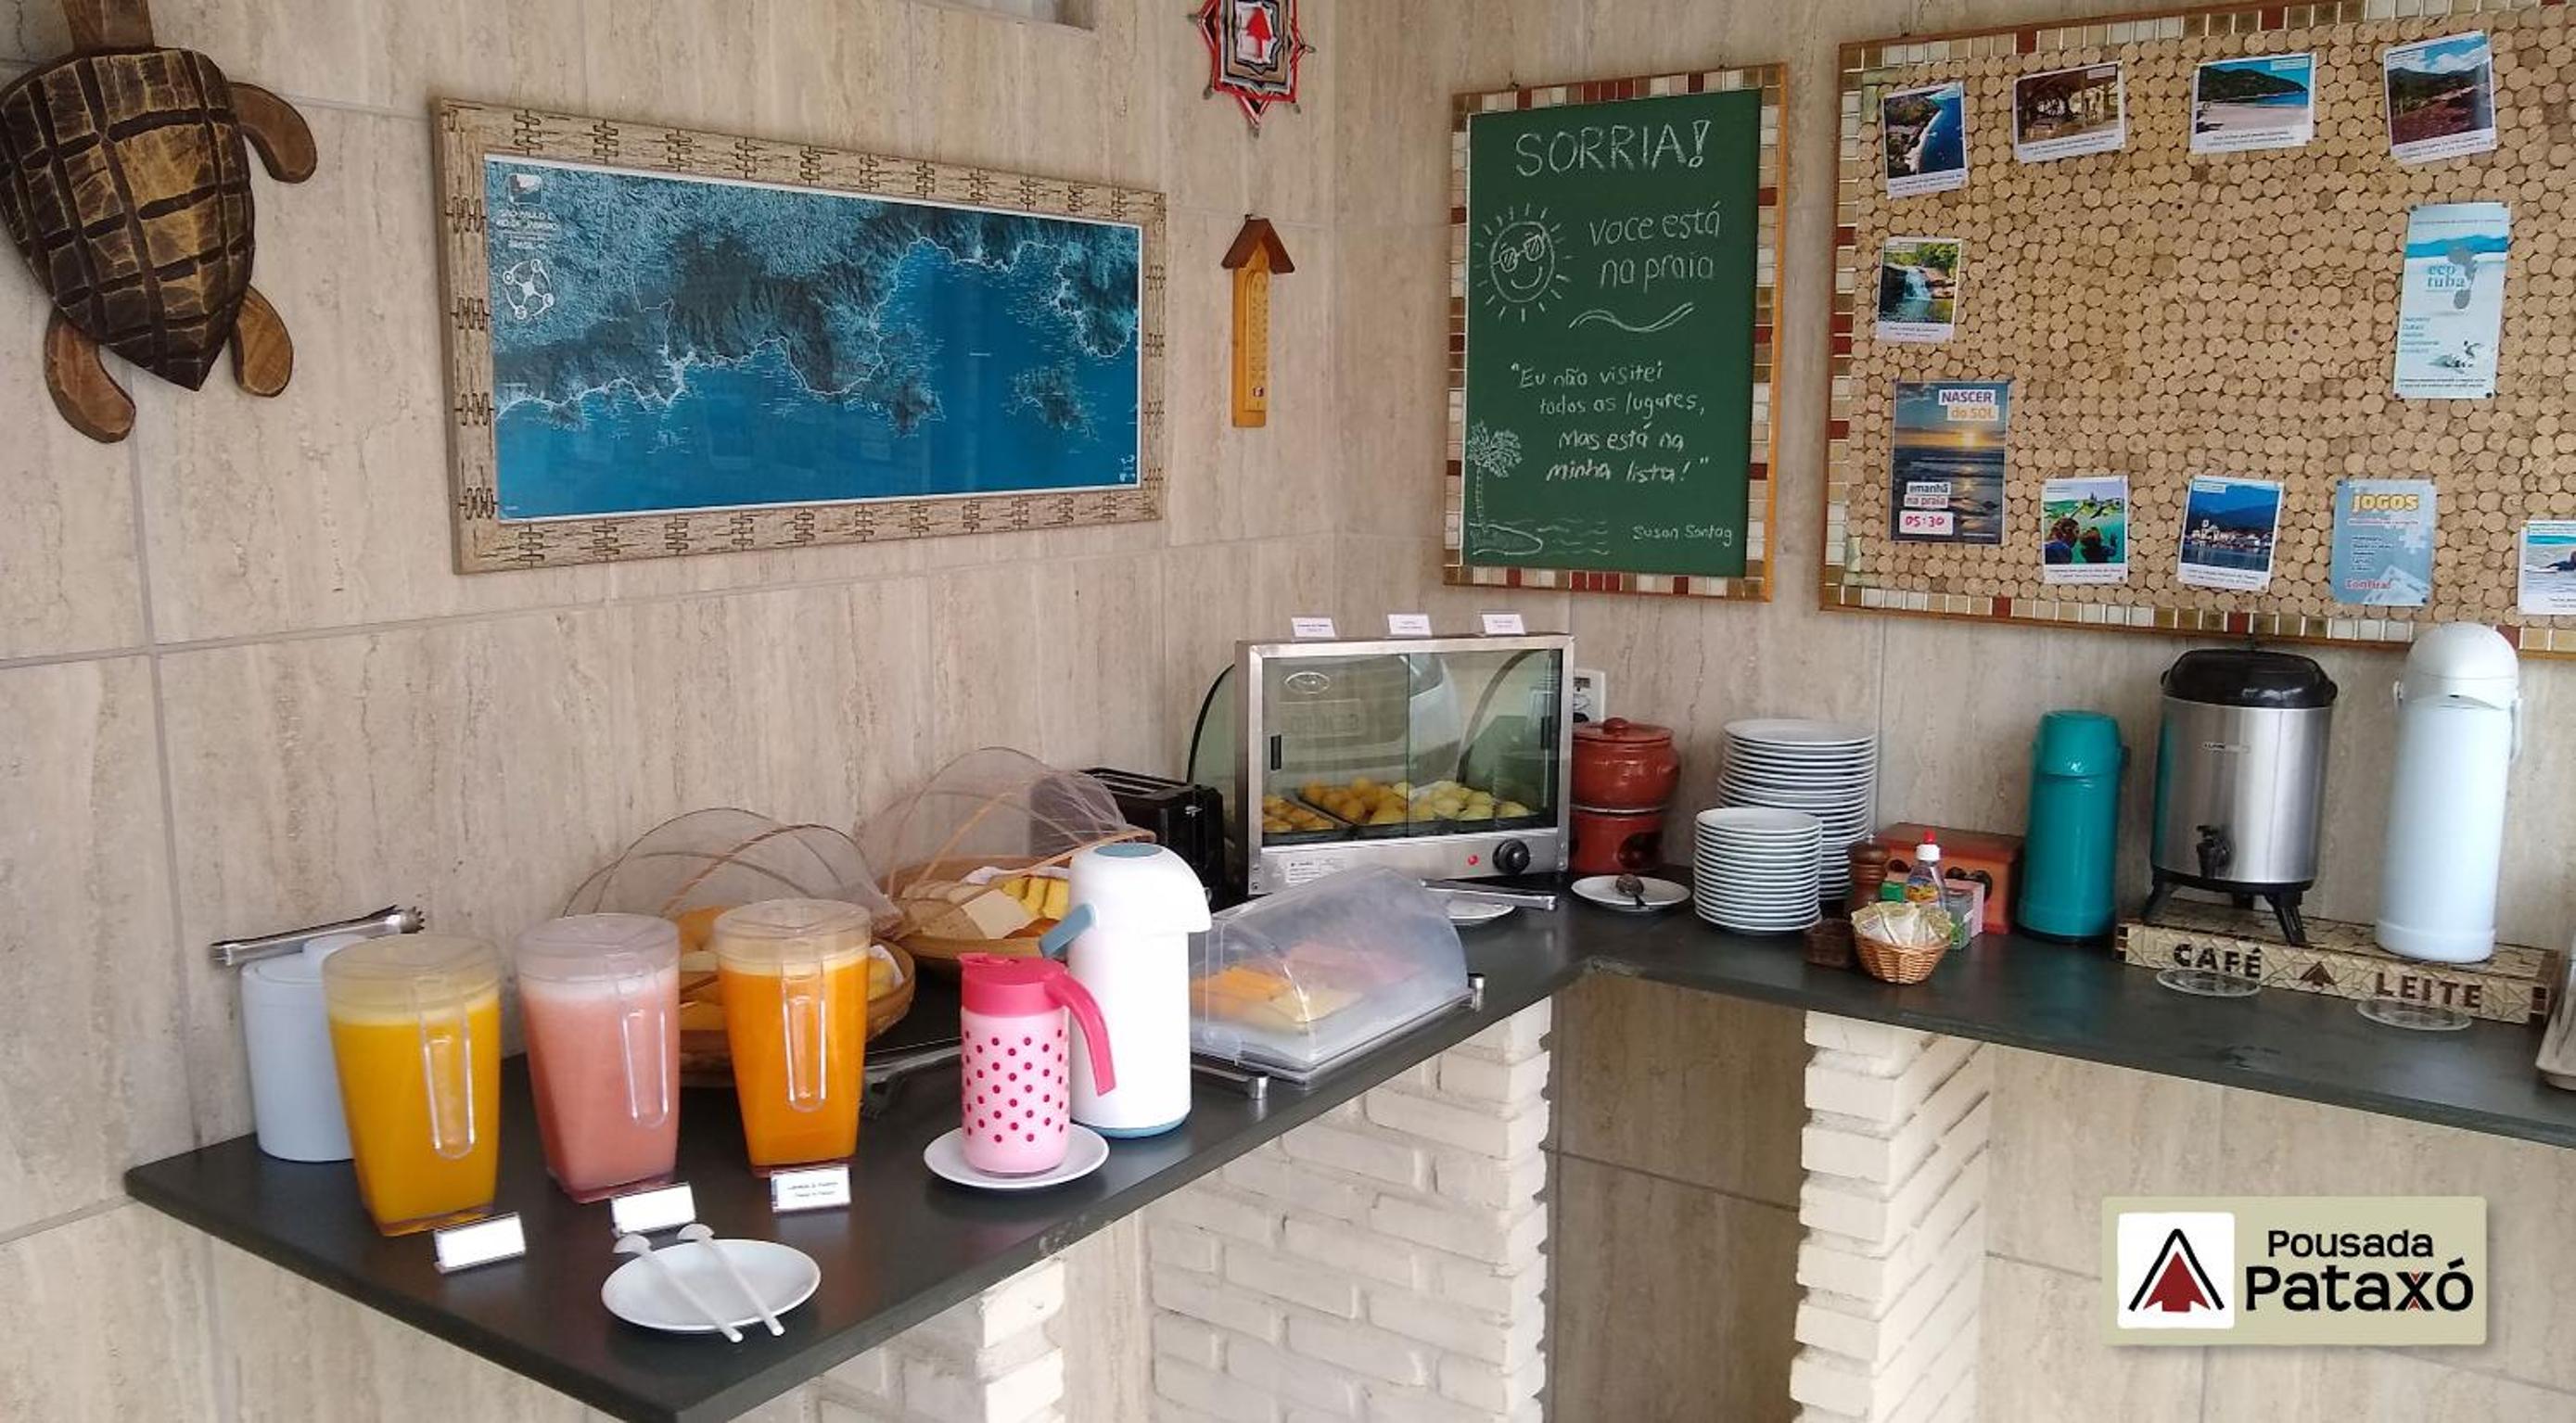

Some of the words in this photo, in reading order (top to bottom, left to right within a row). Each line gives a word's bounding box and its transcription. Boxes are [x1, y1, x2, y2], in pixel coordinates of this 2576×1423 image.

[1515, 120, 1712, 176] SORRIA!
[1662, 201, 1720, 239] está
[1600, 260, 1635, 288] na
[1644, 254, 1713, 293] praia
[2428, 265, 2456, 275] eco
[2428, 274, 2465, 287] tuba
[1553, 369, 1588, 387] não
[1600, 360, 1663, 385] visitei
[1539, 395, 1586, 414] todos
[1942, 391, 1993, 403] NASCER
[1607, 422, 1651, 451] está
[1659, 432, 1684, 452] na
[1906, 497, 1919, 505] na
[1921, 495, 1946, 507] praia
[1906, 515, 1945, 527] 05:30
[1633, 526, 1678, 540] Susan
[2174, 943, 2263, 979] CAFÉ
[2375, 971, 2483, 1009] LEITE
